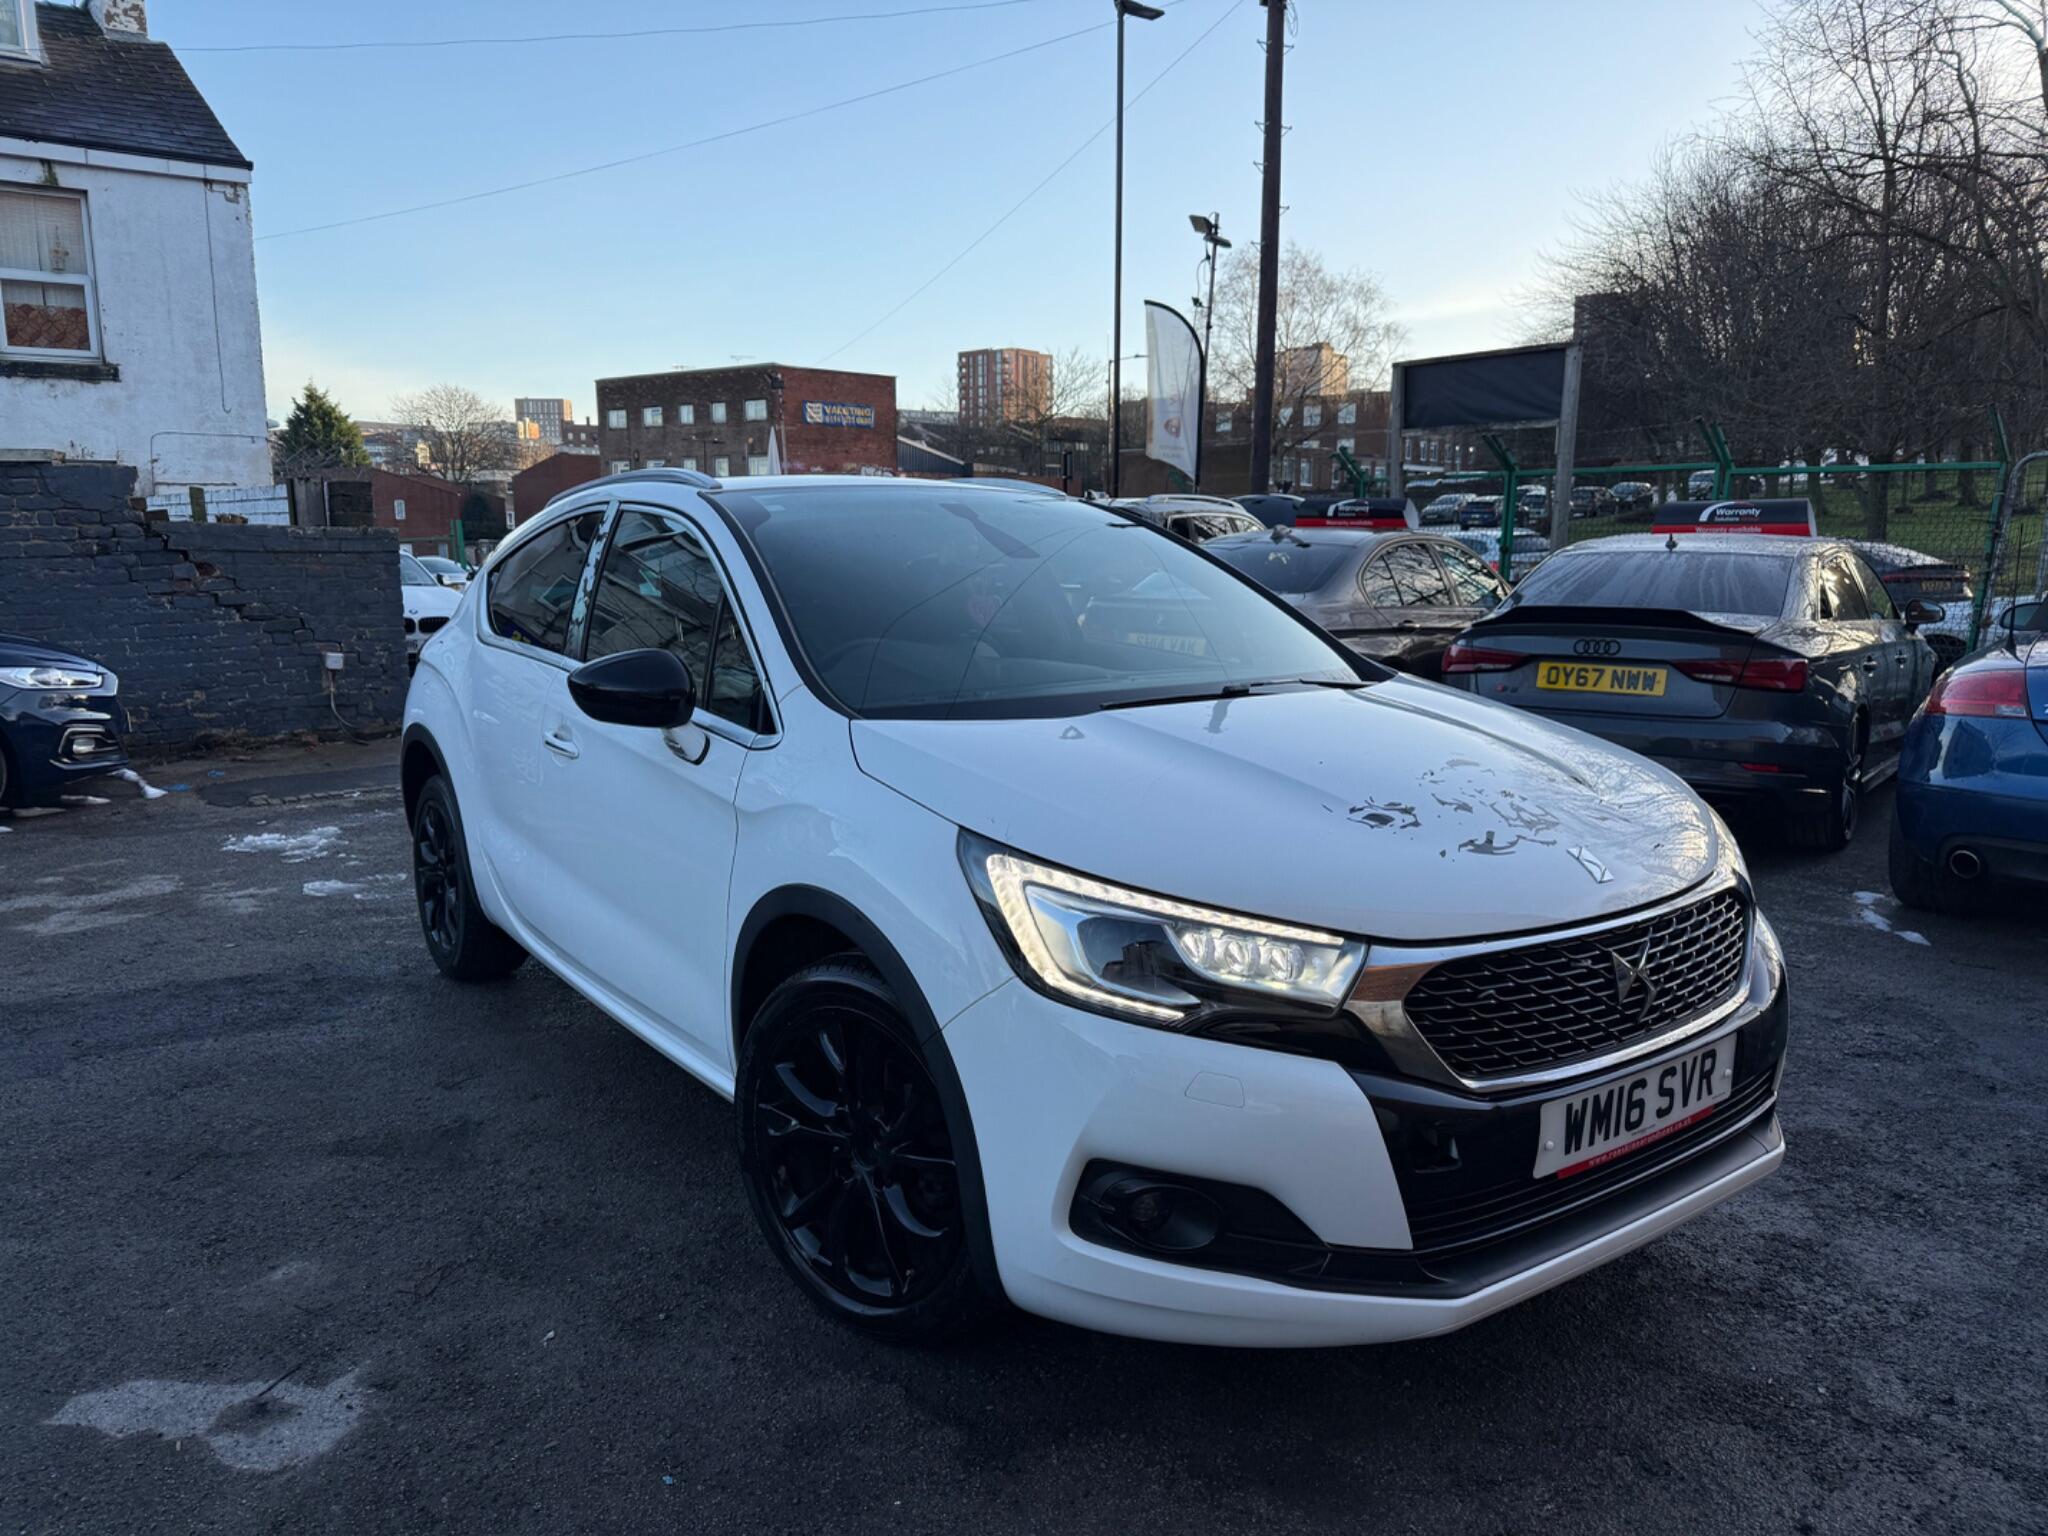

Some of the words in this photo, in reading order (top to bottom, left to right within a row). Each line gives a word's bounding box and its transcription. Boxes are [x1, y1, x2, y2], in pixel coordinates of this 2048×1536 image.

[1715, 508, 1761, 517] Warranty
[1546, 665, 1606, 688] OY67
[1610, 669, 1657, 691] NWW
[1564, 1078, 1648, 1155] WM16
[1656, 1049, 1718, 1119] SVR
